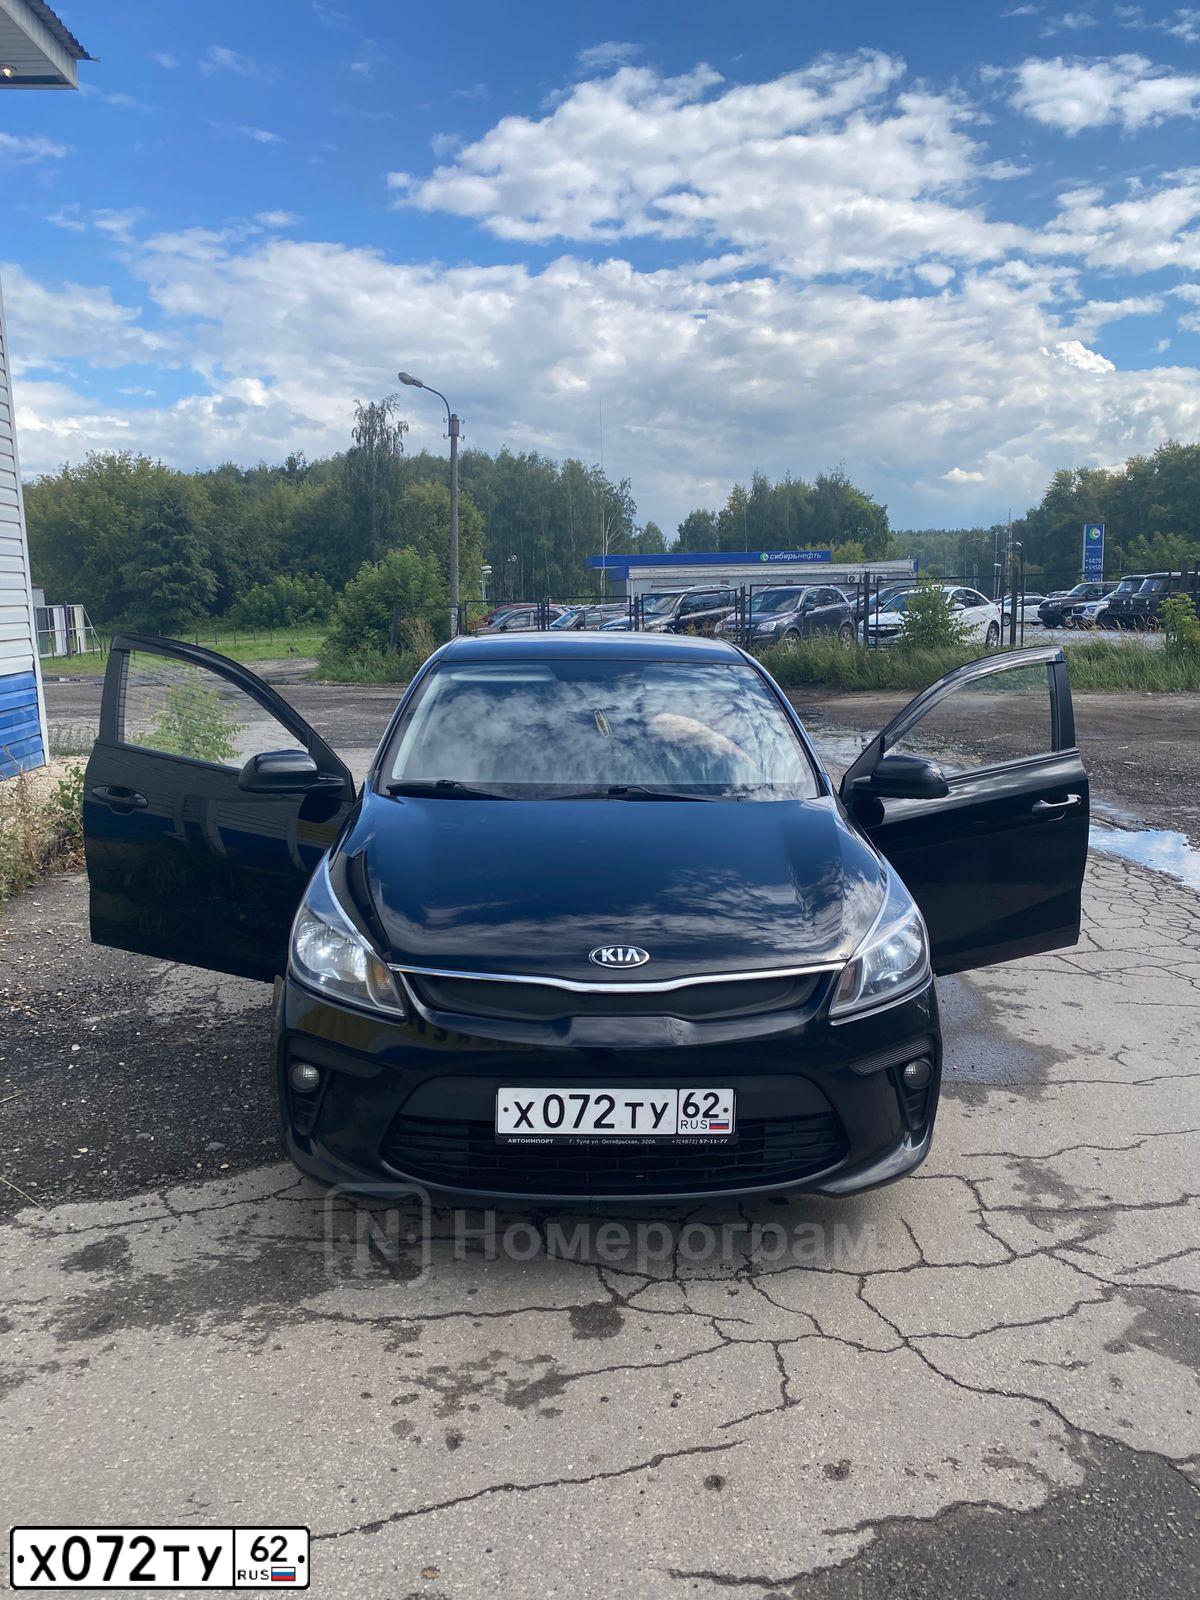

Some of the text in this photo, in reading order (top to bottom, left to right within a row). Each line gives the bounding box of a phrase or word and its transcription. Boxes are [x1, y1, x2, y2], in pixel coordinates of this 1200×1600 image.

[769, 551, 822, 561] сибирьнефть
[601, 948, 640, 962] KIA
[682, 1092, 719, 1119] 62
[680, 1119, 708, 1130] RUS
